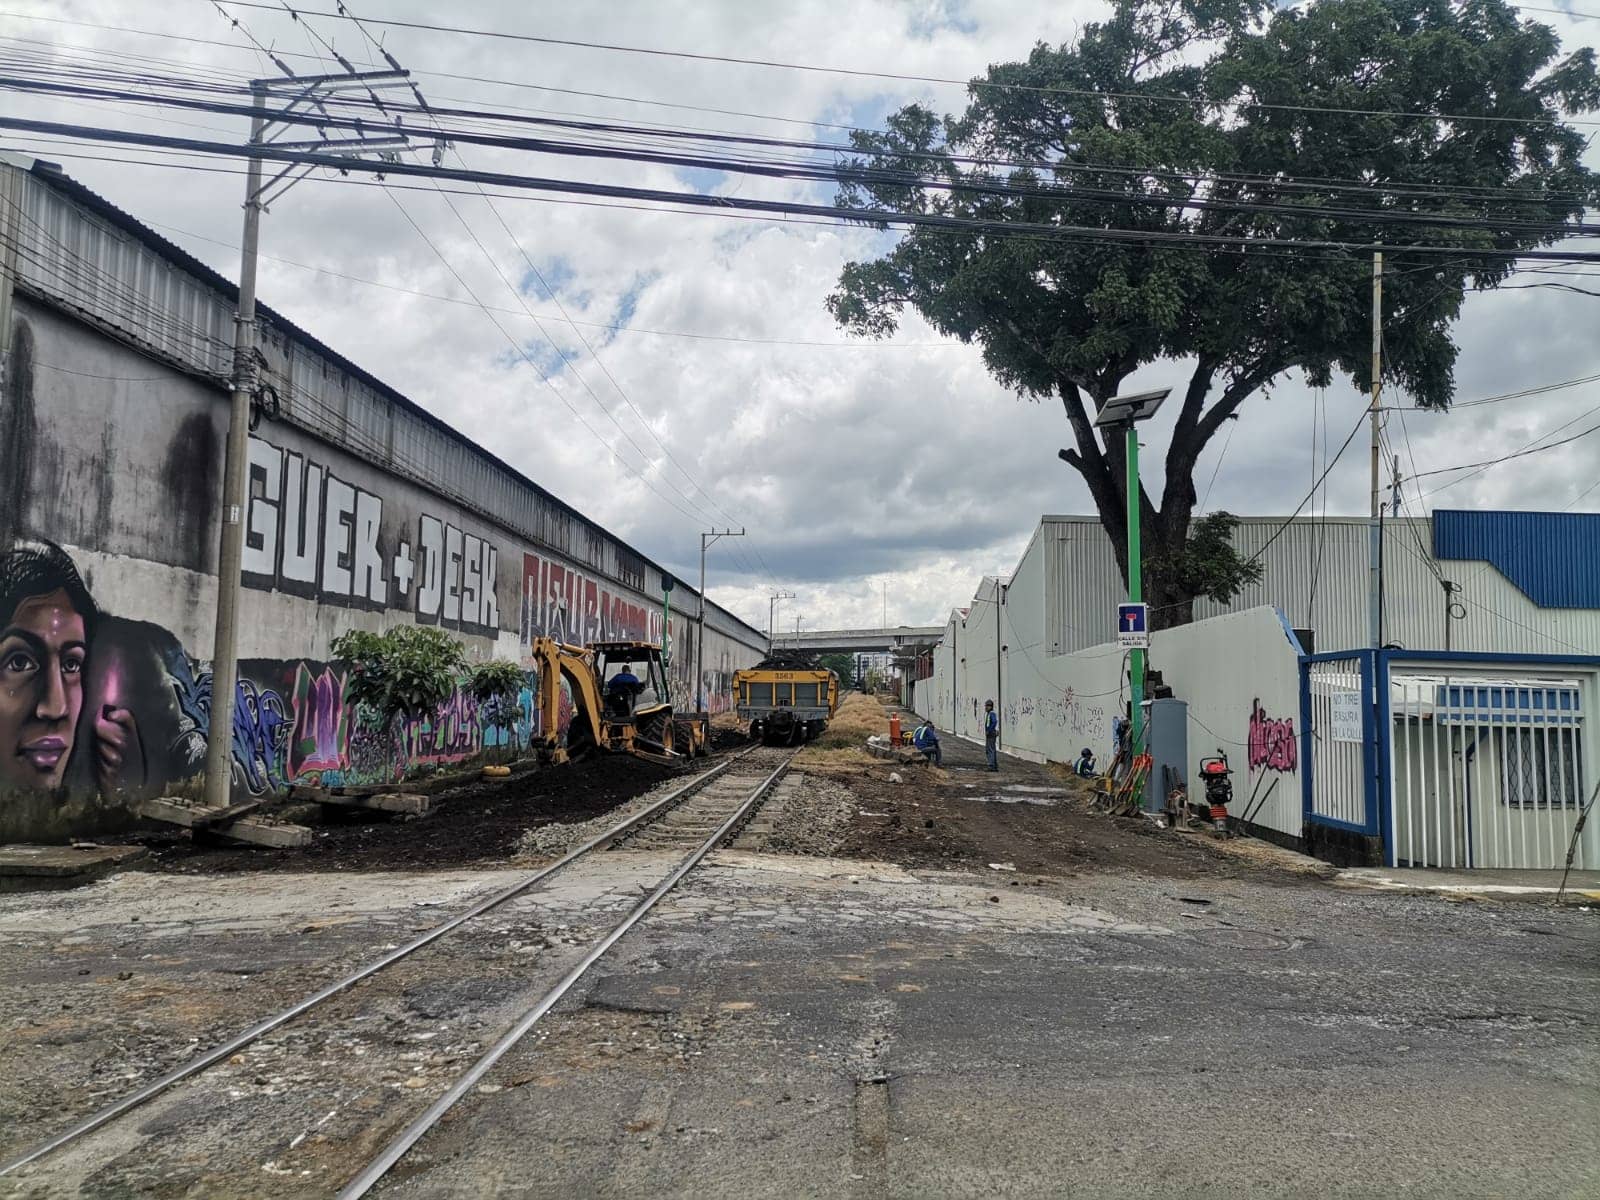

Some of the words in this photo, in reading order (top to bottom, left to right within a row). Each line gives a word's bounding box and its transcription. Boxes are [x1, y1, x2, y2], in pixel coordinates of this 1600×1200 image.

[416, 513, 499, 640] DESK
[1333, 693, 1341, 705] NO
[1344, 694, 1359, 705] TIRE
